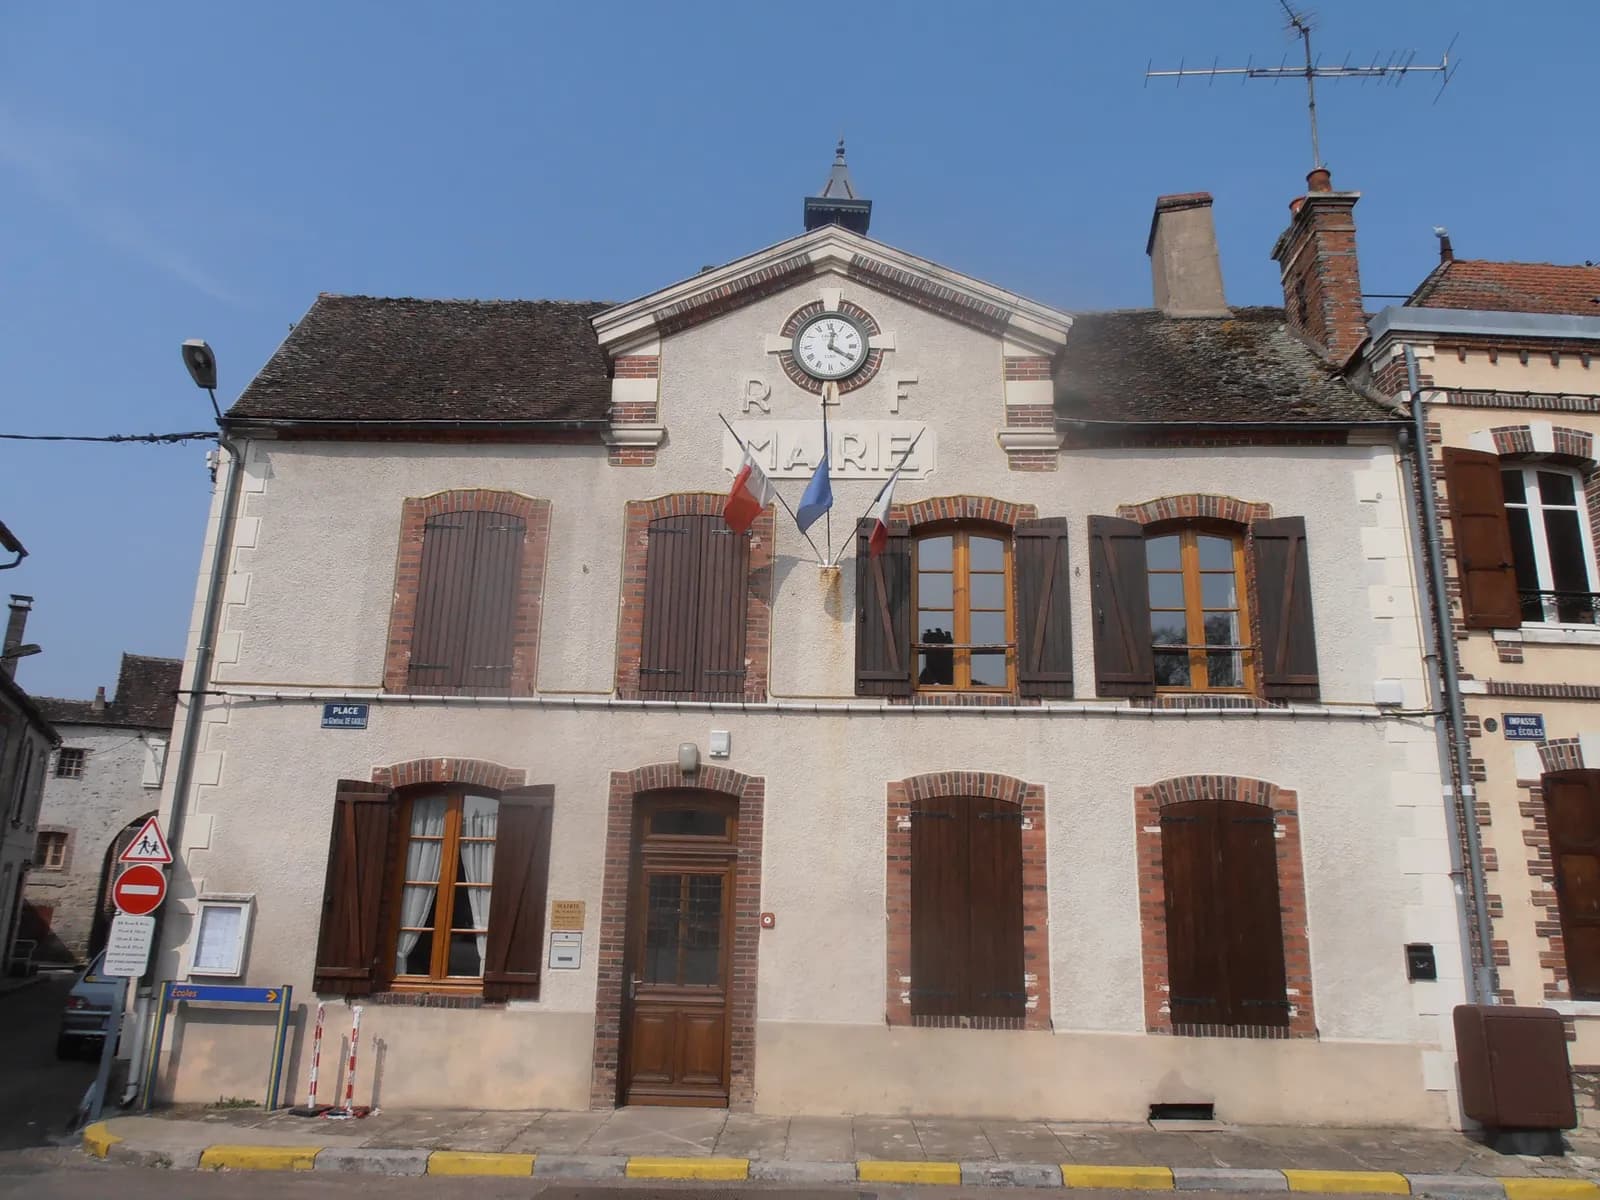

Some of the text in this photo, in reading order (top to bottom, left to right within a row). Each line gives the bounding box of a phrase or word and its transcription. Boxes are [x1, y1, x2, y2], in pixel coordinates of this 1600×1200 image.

[742, 375, 918, 413] R F
[743, 431, 920, 471] MAIRIE
[332, 706, 359, 715] PLACE
[1509, 717, 1537, 725] IMPASSE
[1518, 726, 1544, 736] ÉCOLES
